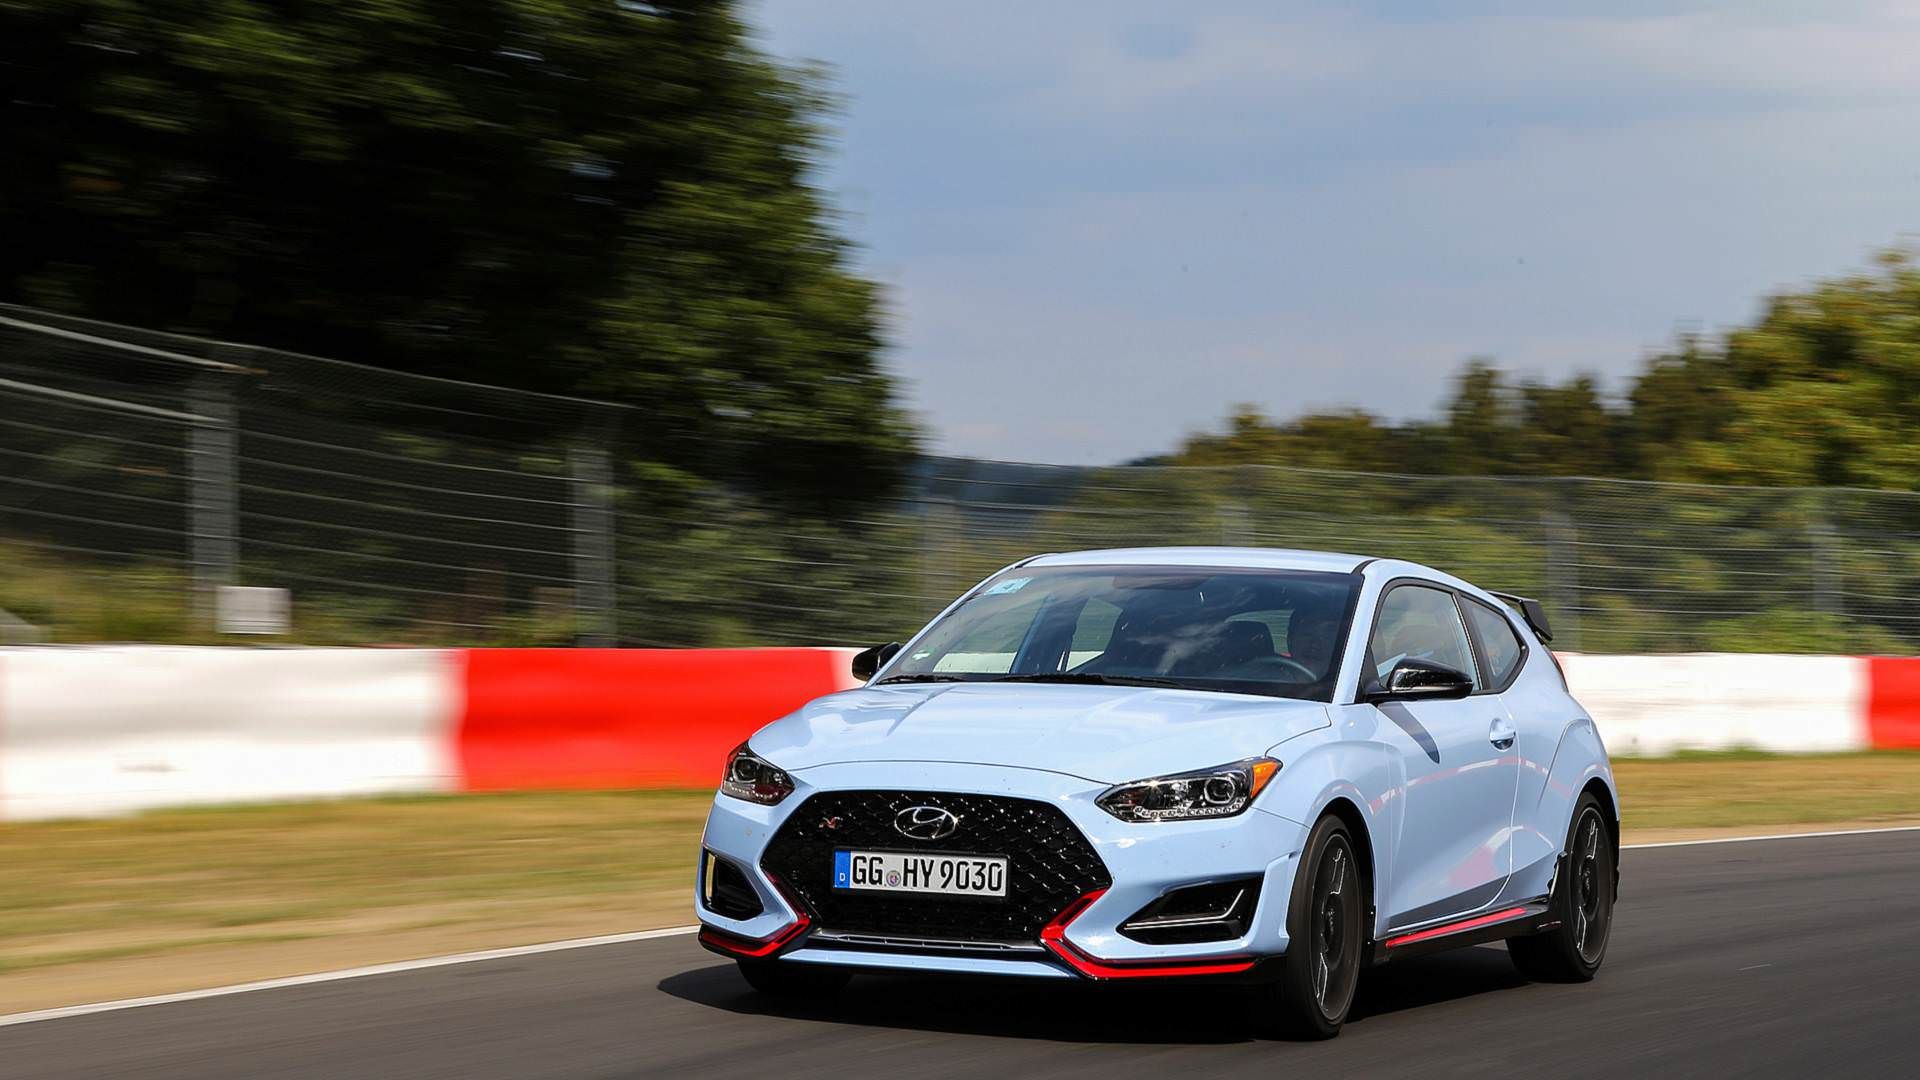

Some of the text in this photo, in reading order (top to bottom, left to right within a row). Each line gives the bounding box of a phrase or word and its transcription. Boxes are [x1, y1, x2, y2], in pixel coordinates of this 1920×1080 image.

[839, 872, 846, 882] D
[852, 855, 1003, 892] GG HY 9030
